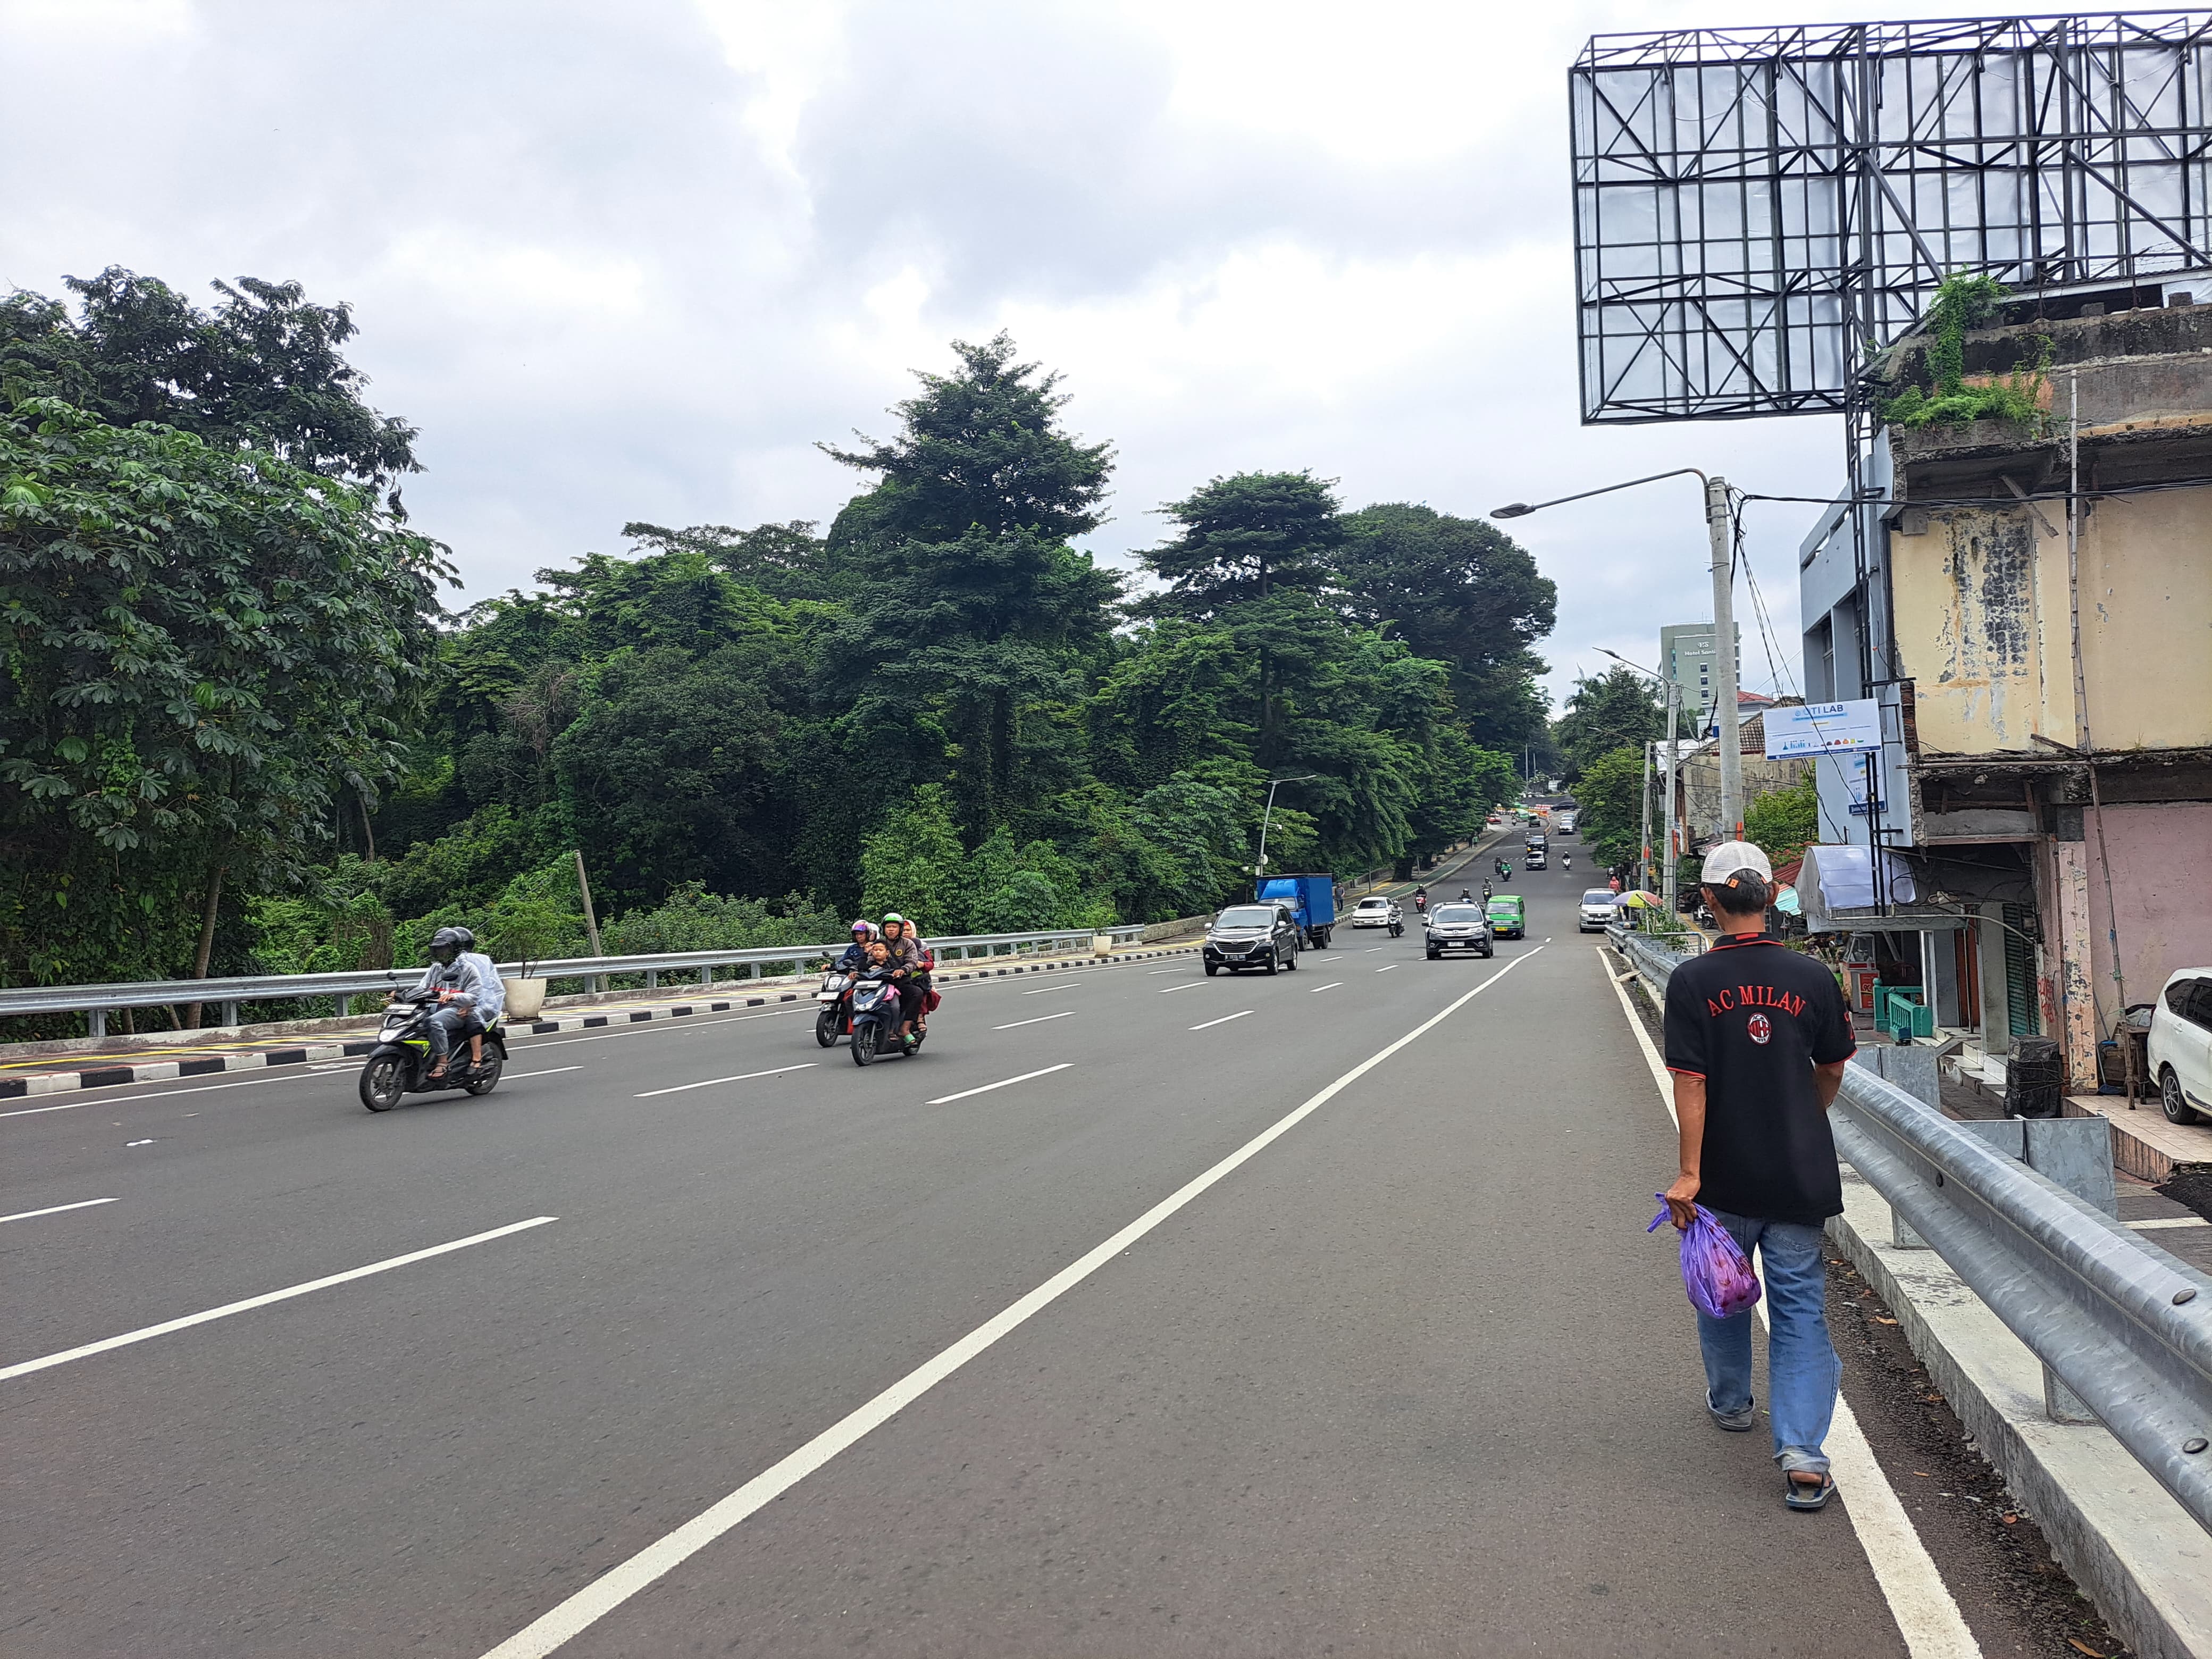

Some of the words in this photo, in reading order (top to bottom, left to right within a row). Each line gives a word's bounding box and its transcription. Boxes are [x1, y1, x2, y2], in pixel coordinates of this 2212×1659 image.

[1823, 705, 1844, 713] LAB
[1707, 990, 1734, 1016] AC
[1738, 986, 1806, 1017] MILAN
